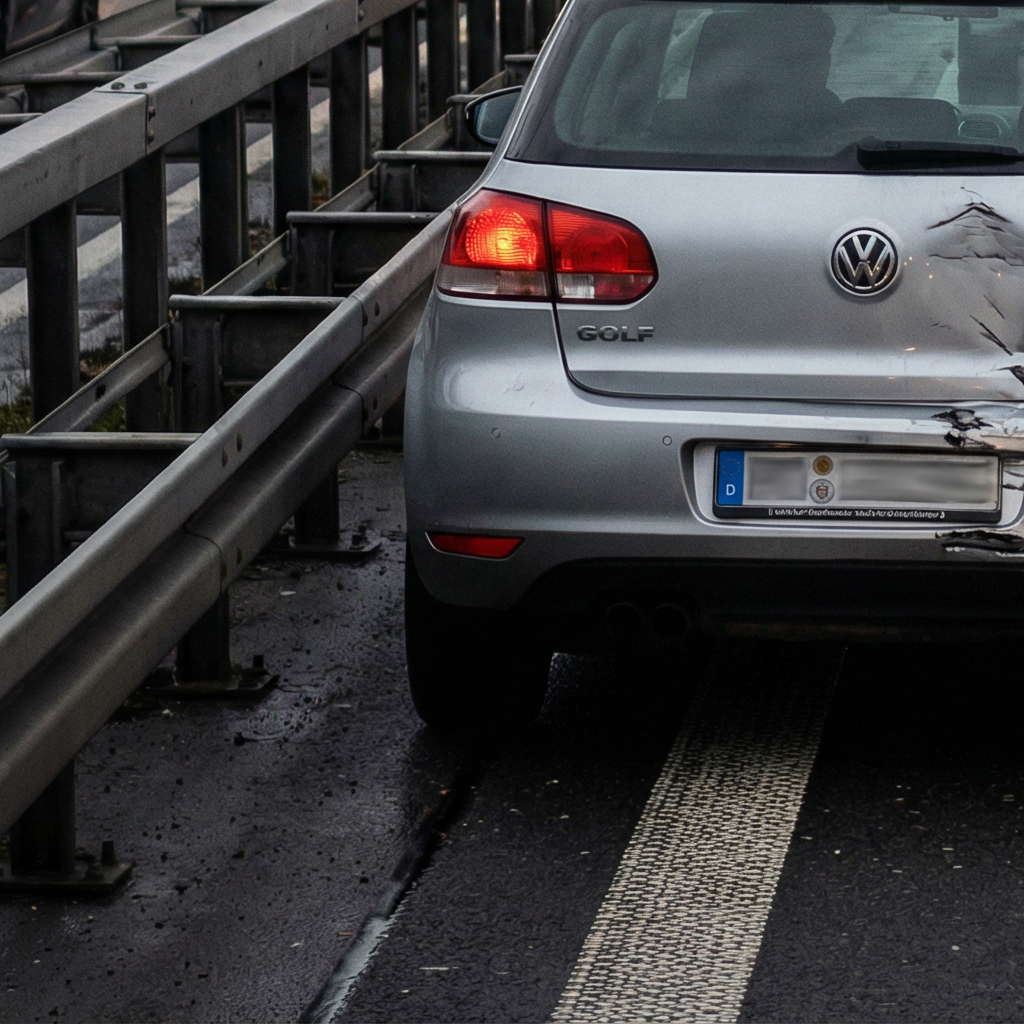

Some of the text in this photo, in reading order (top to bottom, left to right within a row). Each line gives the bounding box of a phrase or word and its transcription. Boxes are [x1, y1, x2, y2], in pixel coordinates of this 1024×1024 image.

[831, 227, 898, 296] VW
[577, 325, 654, 343] GOLF
[725, 484, 736, 496] D
